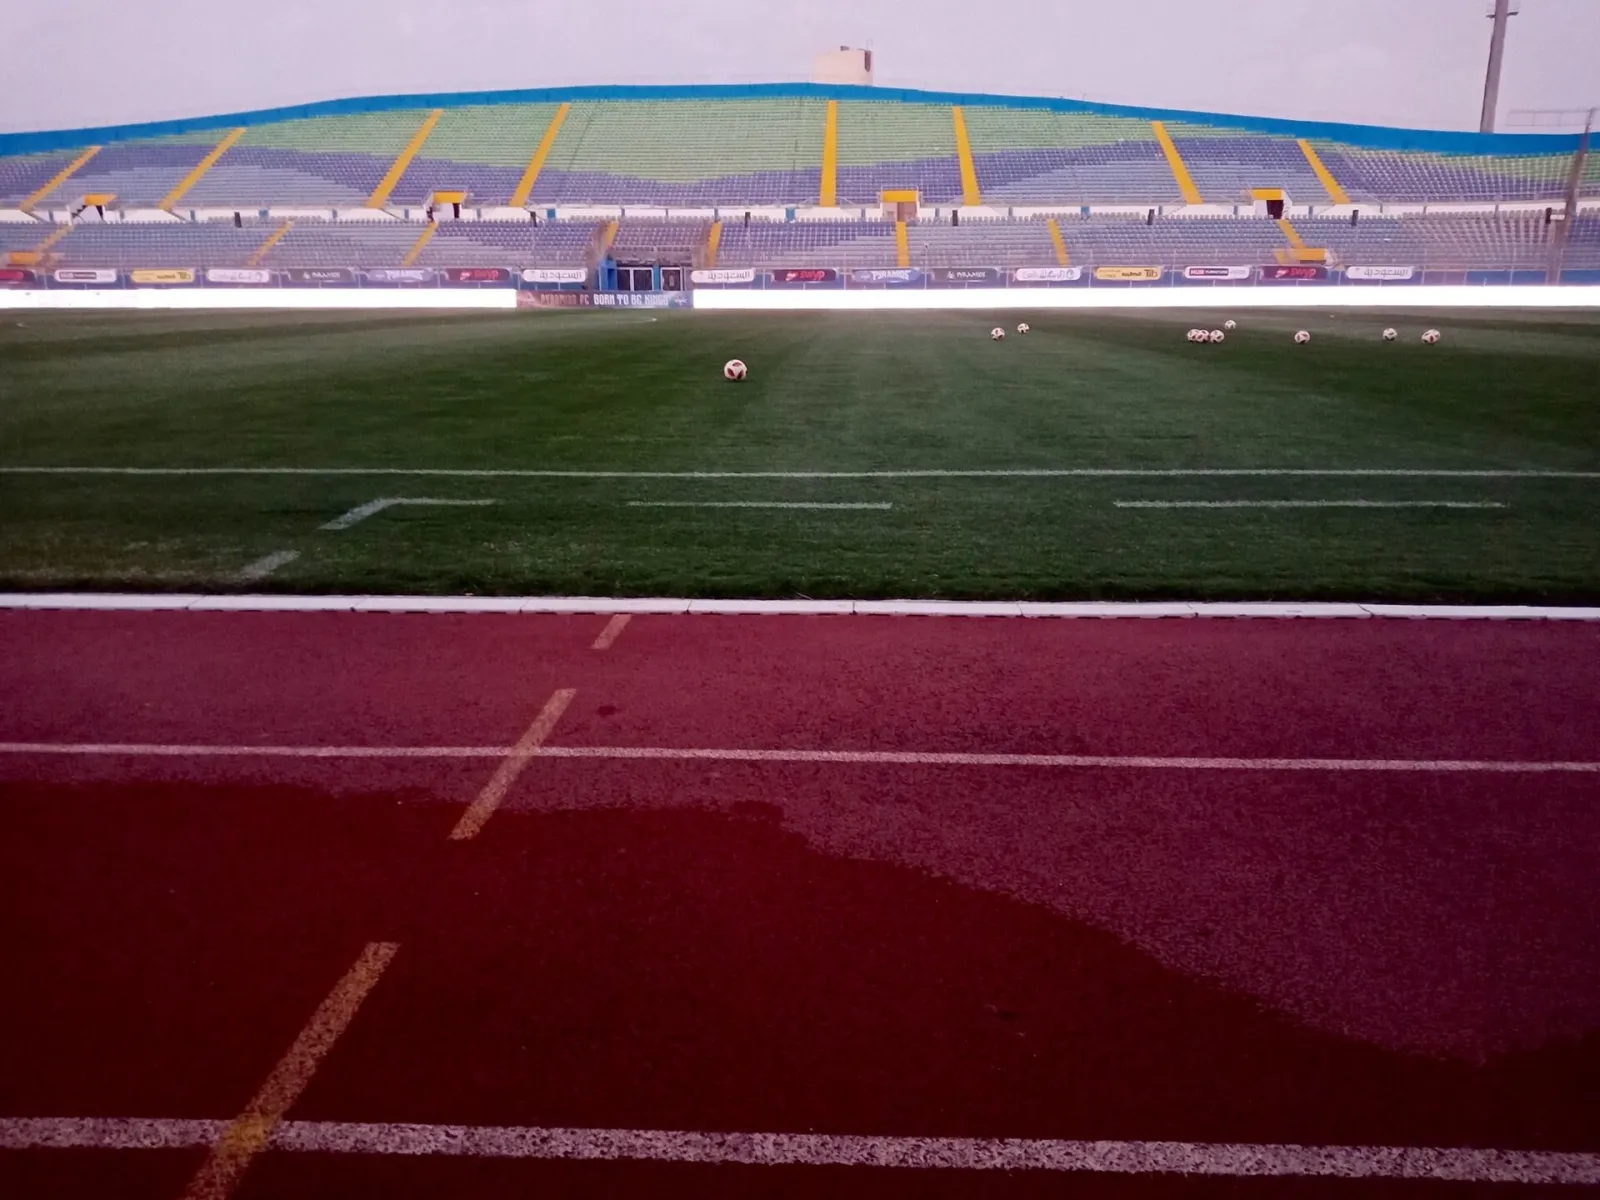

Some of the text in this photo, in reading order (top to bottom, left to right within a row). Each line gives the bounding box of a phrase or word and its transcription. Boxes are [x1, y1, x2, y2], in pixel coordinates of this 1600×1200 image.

[540, 271, 582, 281] السعودية
[708, 270, 751, 281] السعودية
[1364, 268, 1408, 278] السعودية
[593, 293, 616, 305] BORN
[617, 293, 629, 305] TO
[631, 293, 643, 305] BE
